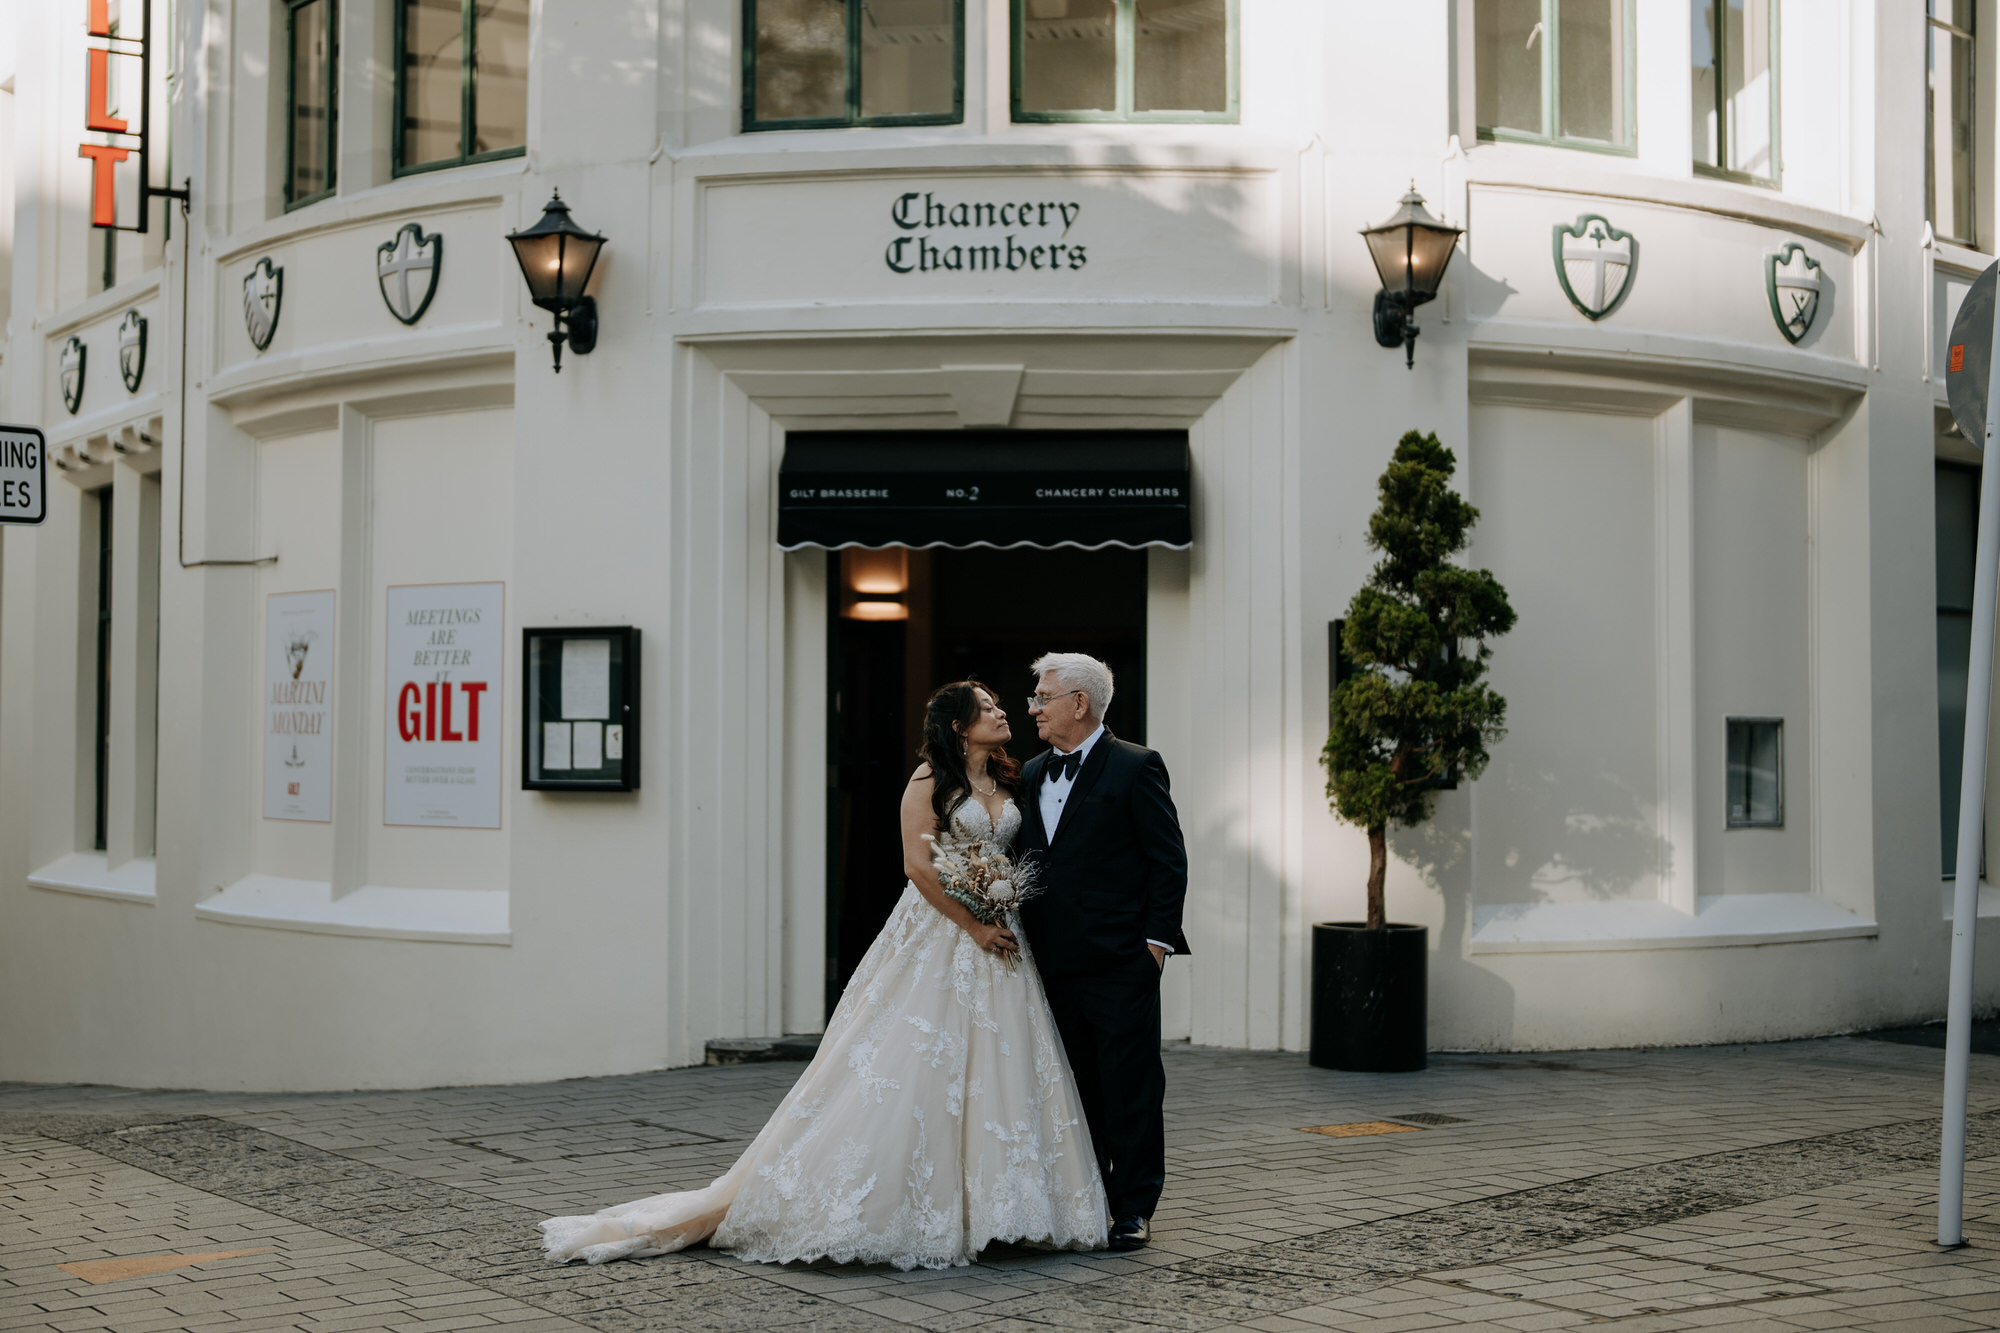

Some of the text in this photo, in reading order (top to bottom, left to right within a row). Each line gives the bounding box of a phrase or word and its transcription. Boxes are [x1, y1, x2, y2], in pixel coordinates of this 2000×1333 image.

[892, 191, 1081, 239] Chancery
[885, 234, 1088, 274] Chambers
[0, 440, 37, 469] ING
[0, 480, 31, 508] ES
[789, 489, 889, 498] GILT BRASSERIE
[1035, 488, 1180, 498] CHANCERY CHAMBERS
[405, 607, 482, 626] MEETINGS
[426, 629, 456, 646] ARE
[413, 649, 472, 667] BETTER
[270, 680, 326, 705] MARTINI
[270, 711, 326, 735] MONDAY
[398, 681, 488, 742] GILT
